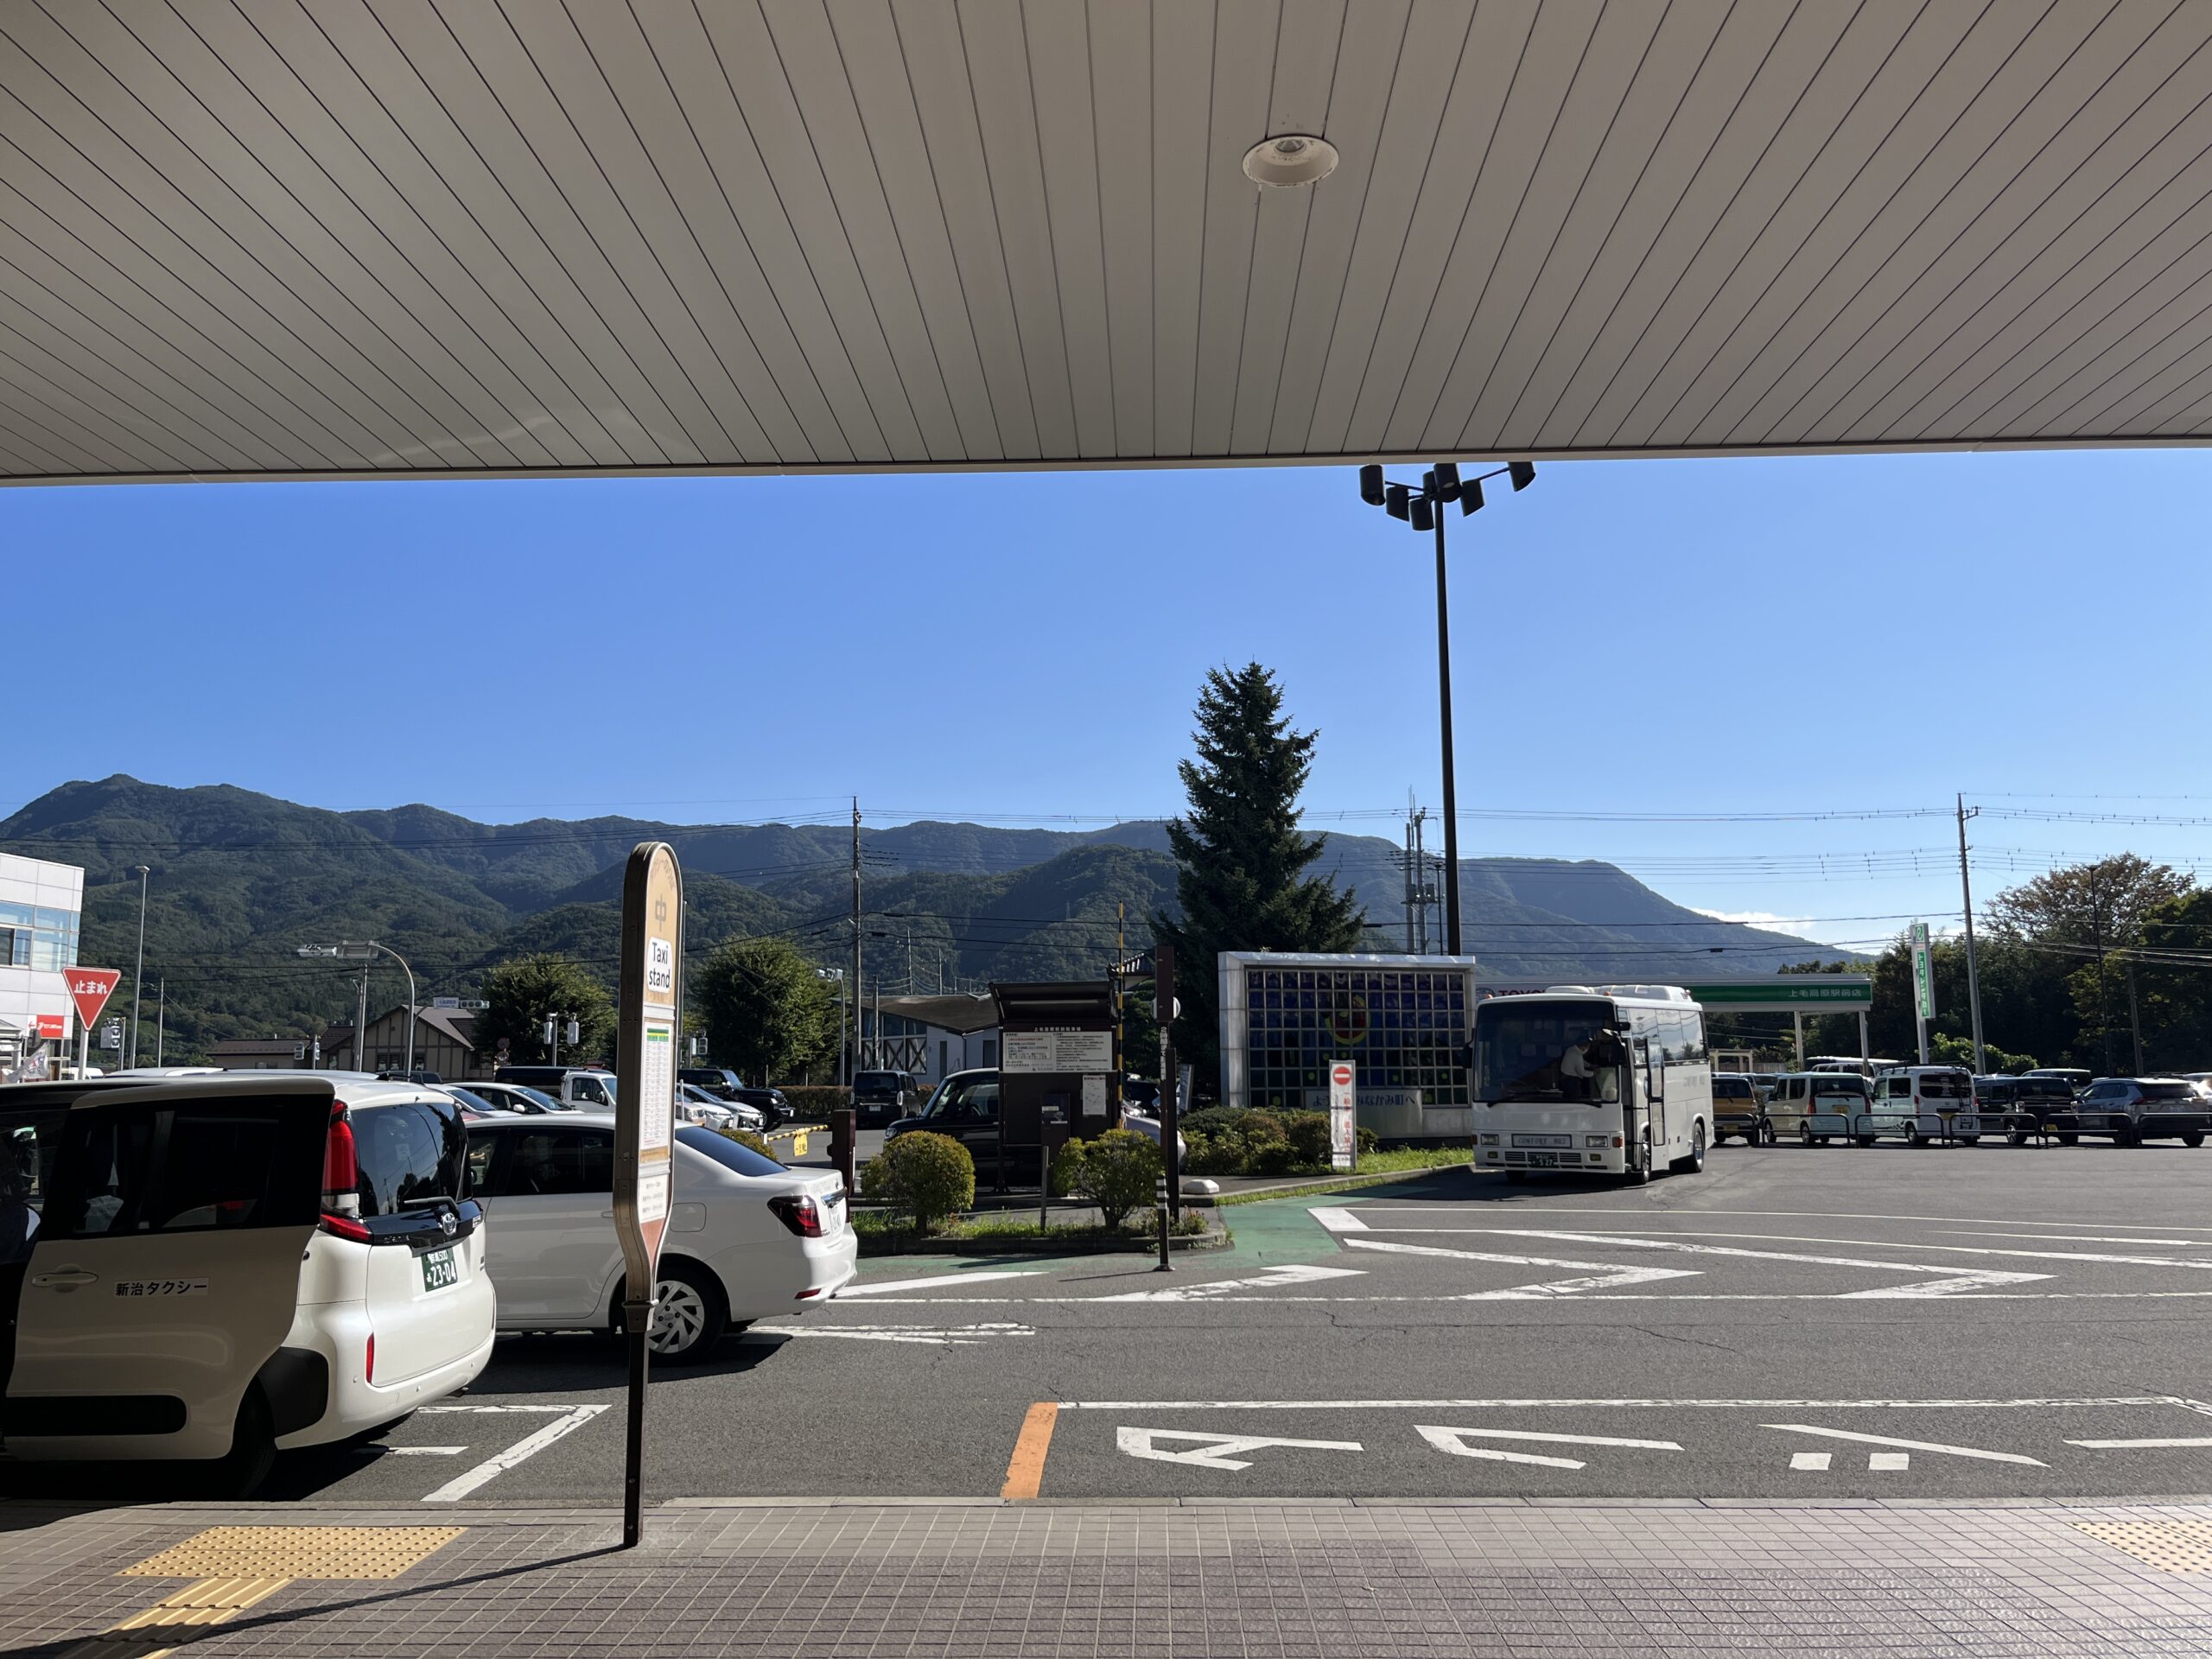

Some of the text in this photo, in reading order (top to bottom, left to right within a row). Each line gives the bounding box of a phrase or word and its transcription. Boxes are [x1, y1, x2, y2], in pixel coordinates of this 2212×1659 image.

[652, 942, 669, 963] Taxi
[648, 967, 671, 989] stand
[73, 979, 108, 995] 止まれ
[1788, 988, 1862, 998] 上毛高原駅前店
[115, 1281, 207, 1297] 新治タクシー
